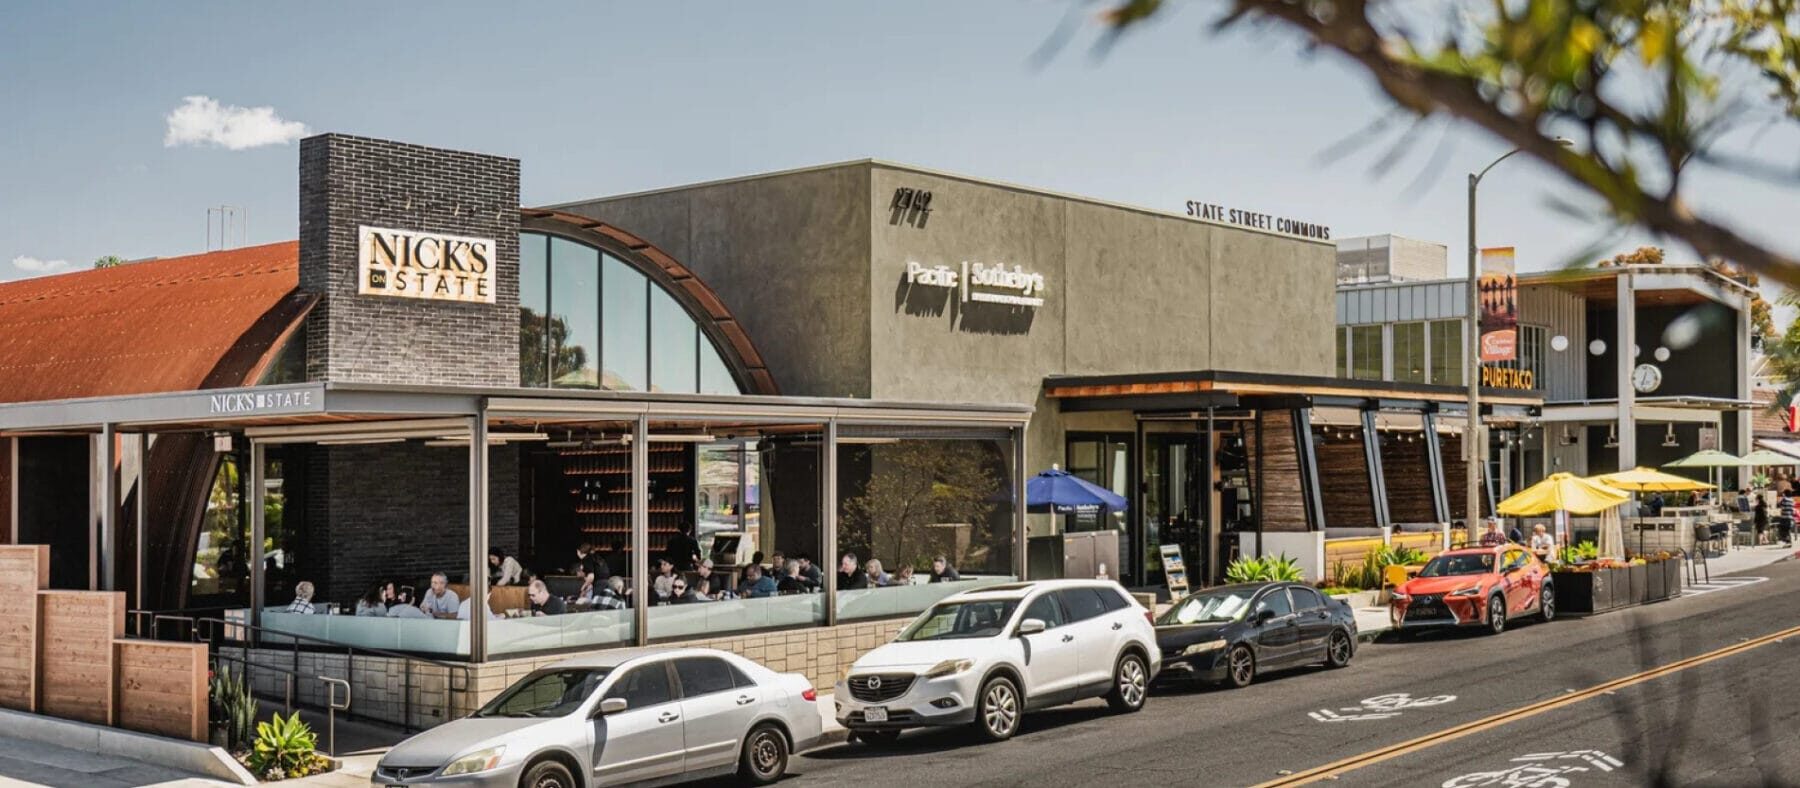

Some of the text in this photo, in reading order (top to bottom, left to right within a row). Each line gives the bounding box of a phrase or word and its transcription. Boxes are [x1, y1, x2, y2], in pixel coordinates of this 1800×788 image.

[1186, 200, 1330, 240] STATE STREET COMMONS
[370, 232, 488, 273] NICK'S
[396, 271, 488, 296] STATE
[971, 262, 1044, 295] Sotheby's
[1482, 366, 1533, 390] PURETACO
[267, 391, 312, 408] STATE
